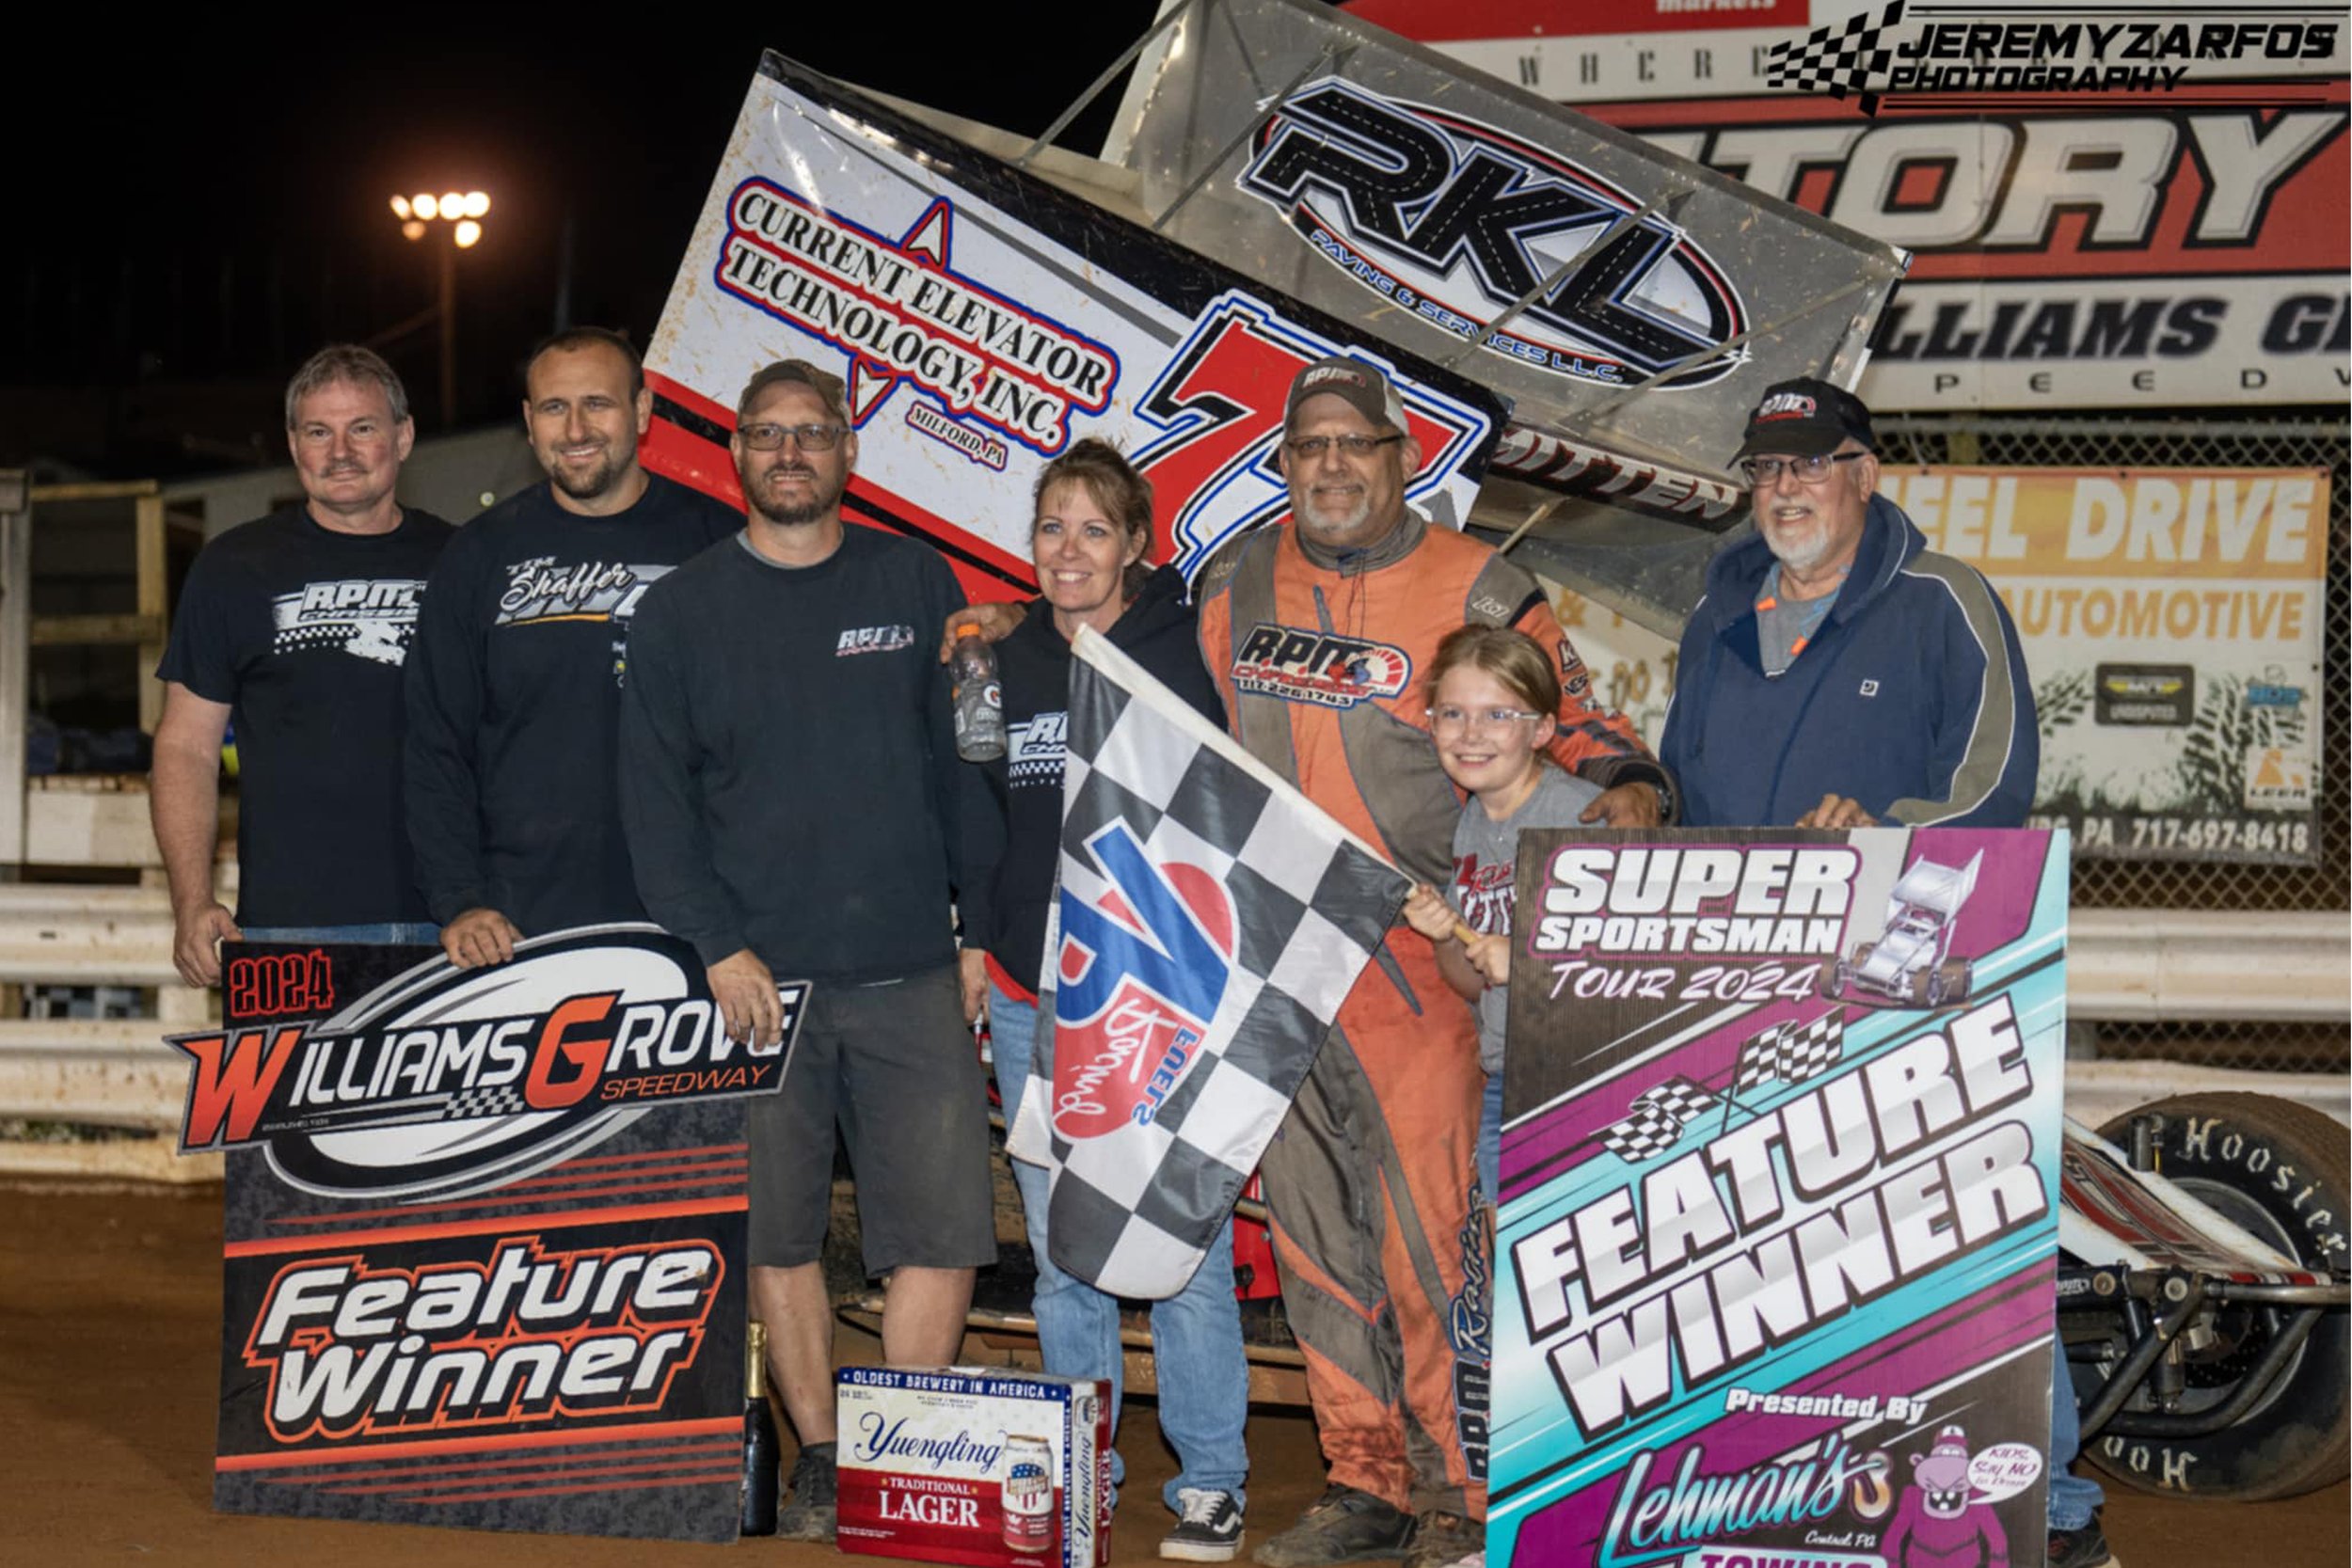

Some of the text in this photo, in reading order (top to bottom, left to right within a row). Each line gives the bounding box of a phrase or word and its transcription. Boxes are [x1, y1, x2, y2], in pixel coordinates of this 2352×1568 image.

[1244, 79, 1739, 372] RKL
[739, 191, 1109, 403] CURRENT ELEVATOR
[1311, 230, 1394, 295] PAVING
[1397, 293, 1414, 311] &
[1418, 302, 1551, 365] SERVICES
[726, 242, 1061, 442] TECHNOLOGY, INC.
[911, 405, 1005, 467] MILFORD, PA
[2064, 477, 2316, 563] DRIVE
[500, 561, 633, 611] Shaffer
[2080, 816, 2115, 847] PA
[2131, 816, 2312, 855] 717-697-8418
[1545, 847, 1859, 916] SUPER
[1535, 916, 1844, 954] SPORTSMAN
[230, 950, 334, 1018] 2024
[1549, 961, 1822, 1002] TOUR 2024
[171, 1019, 535, 1147] WILLIAMS
[600, 1064, 771, 1101] SPEEDWAY
[1511, 992, 2034, 1343] FEATURE
[2178, 1117, 2347, 1257] Hoosier
[258, 1247, 714, 1347] Feature
[1547, 1120, 2049, 1440] WINNER
[268, 1327, 687, 1423] Winner
[852, 1370, 1046, 1399] OLDEST BREWERY IN AMERICA
[1725, 1387, 1929, 1425] Presented By
[852, 1411, 1009, 1473] Yuengling
[879, 1490, 980, 1528] LAGER
[889, 1477, 971, 1497] TRADITIONAL
[1073, 1434, 1093, 1548] Yuengling
[1597, 1431, 1882, 1568] Lehman's
